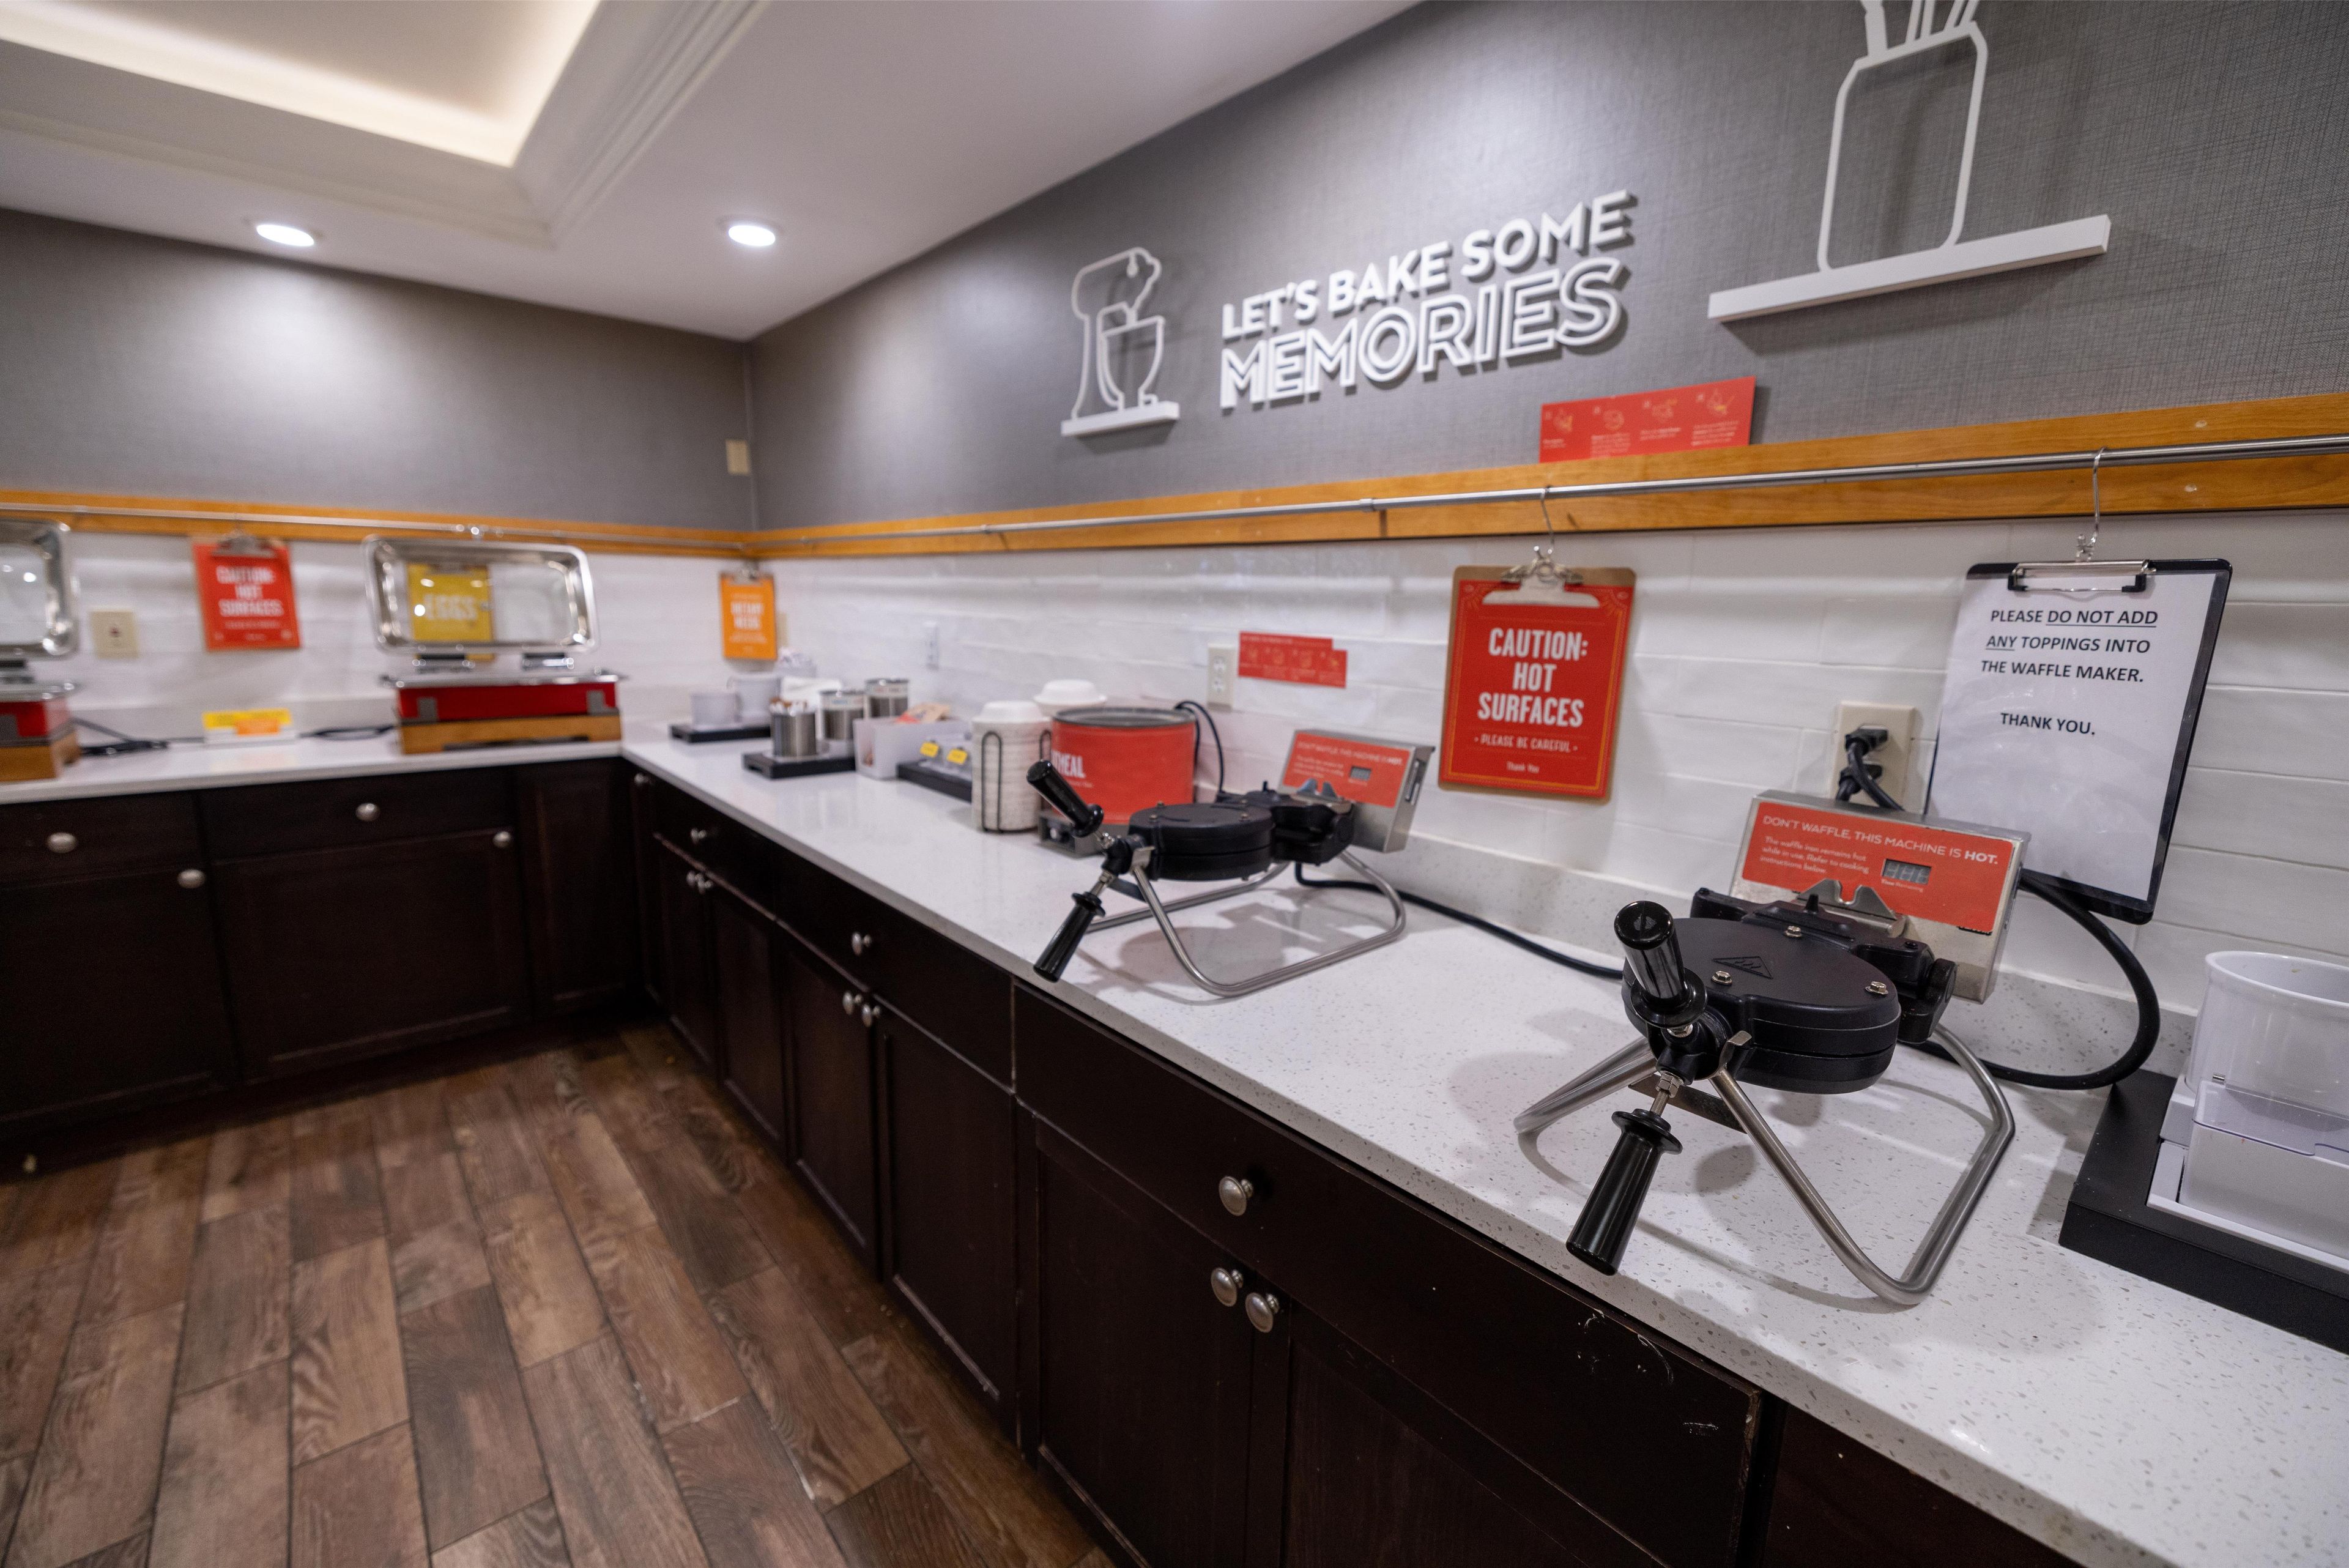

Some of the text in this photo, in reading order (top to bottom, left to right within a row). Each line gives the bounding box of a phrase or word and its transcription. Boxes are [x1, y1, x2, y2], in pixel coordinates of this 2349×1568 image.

[1221, 189, 1631, 339] LET'S BAKE SOME
[1219, 256, 1623, 408] MEMORIES
[1991, 610, 2158, 625] PLEASE DO NOT ADD
[1488, 627, 1589, 661] CAUTION:
[1986, 636, 2151, 653] ANY TOPPINGS INTO
[1512, 661, 1557, 693] HOT
[1981, 660, 2144, 683] THE WAFFLE MAKER.
[1477, 692, 1584, 727] SURFACES
[2001, 713, 2096, 735] THANK YOU.
[1480, 734, 1571, 753] PLEASE BE CAREFUL
[1762, 815, 1800, 830] DON'T
[1855, 831, 1883, 845] THIS
[1884, 836, 1947, 855] MACHINE
[1950, 847, 1962, 858] IS
[1964, 850, 1998, 864] HOT.
